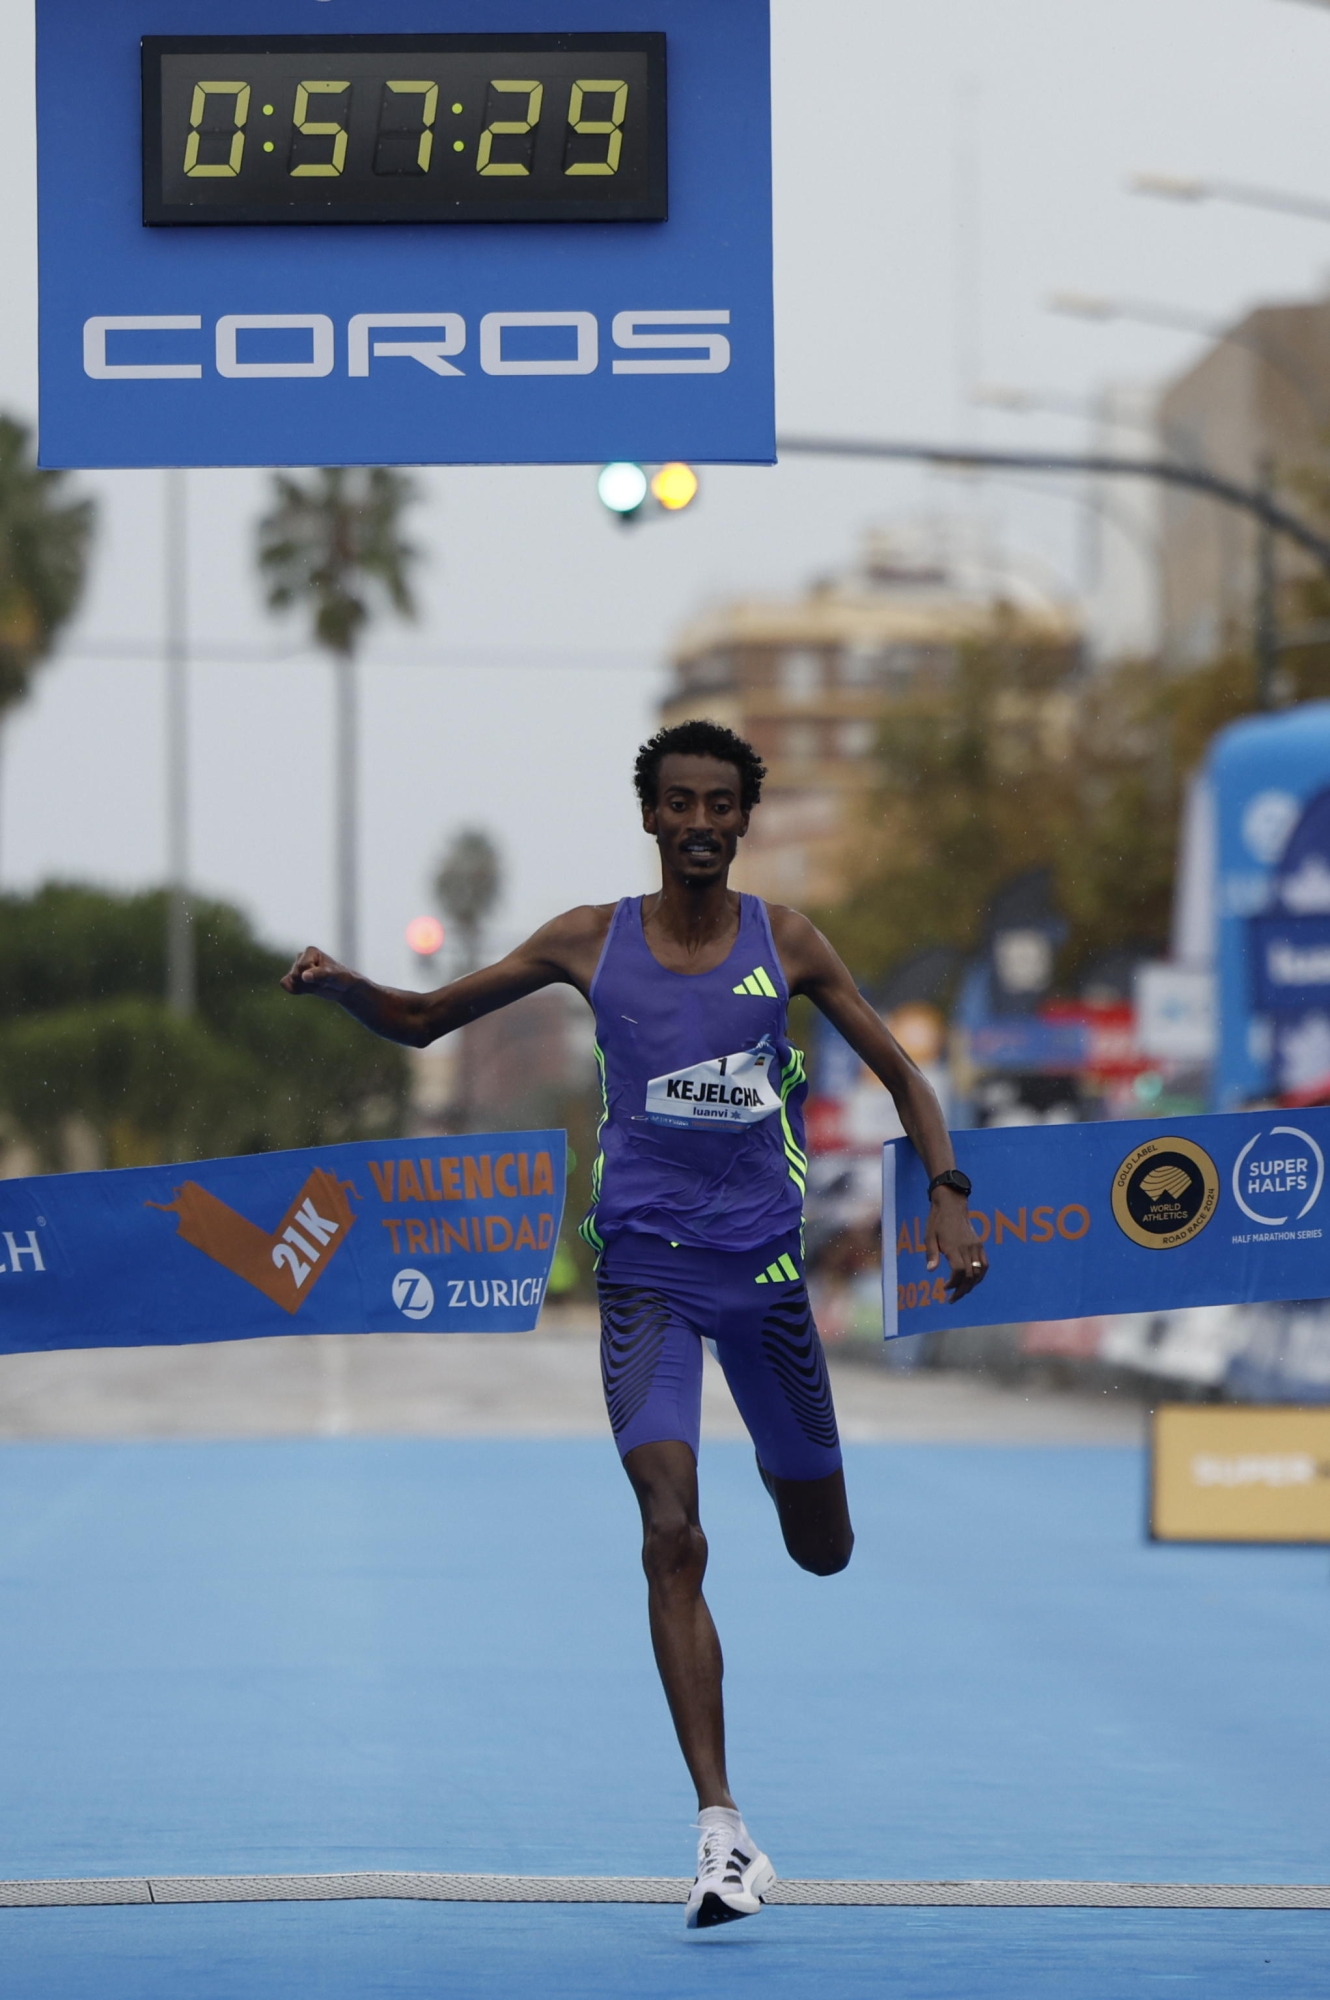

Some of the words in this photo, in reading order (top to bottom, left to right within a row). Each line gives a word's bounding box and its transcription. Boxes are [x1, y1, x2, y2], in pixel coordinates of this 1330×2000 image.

[183, 80, 628, 177] 0:57:29
[83, 309, 731, 380] COROS
[718, 1057, 728, 1077] 1
[666, 1079, 765, 1107] KEJELCHA
[367, 1151, 555, 1202] VALENCIA
[1117, 1162, 1133, 1187] GOLD
[1131, 1144, 1159, 1164] LABEL
[1247, 1175, 1307, 1194] HALFS
[1249, 1157, 1308, 1176] SUPER
[1141, 1210, 1188, 1222] ATHLETICS
[1150, 1203, 1181, 1213] WORLD
[1162, 1231, 1188, 1244] ROAD
[1187, 1214, 1208, 1233] RACE
[1204, 1188, 1216, 1212] 2024
[272, 1197, 340, 1289] 21K
[381, 1213, 554, 1255] TRINIDAD
[896, 1203, 1091, 1256] ALONSO
[1232, 1234, 1252, 1244] HALF
[1252, 1231, 1296, 1243] MARATHON
[1296, 1228, 1323, 1240] SERIES
[0, 1230, 47, 1274] H
[446, 1277, 543, 1308] ZURICH
[897, 1277, 948, 1311] 2024
